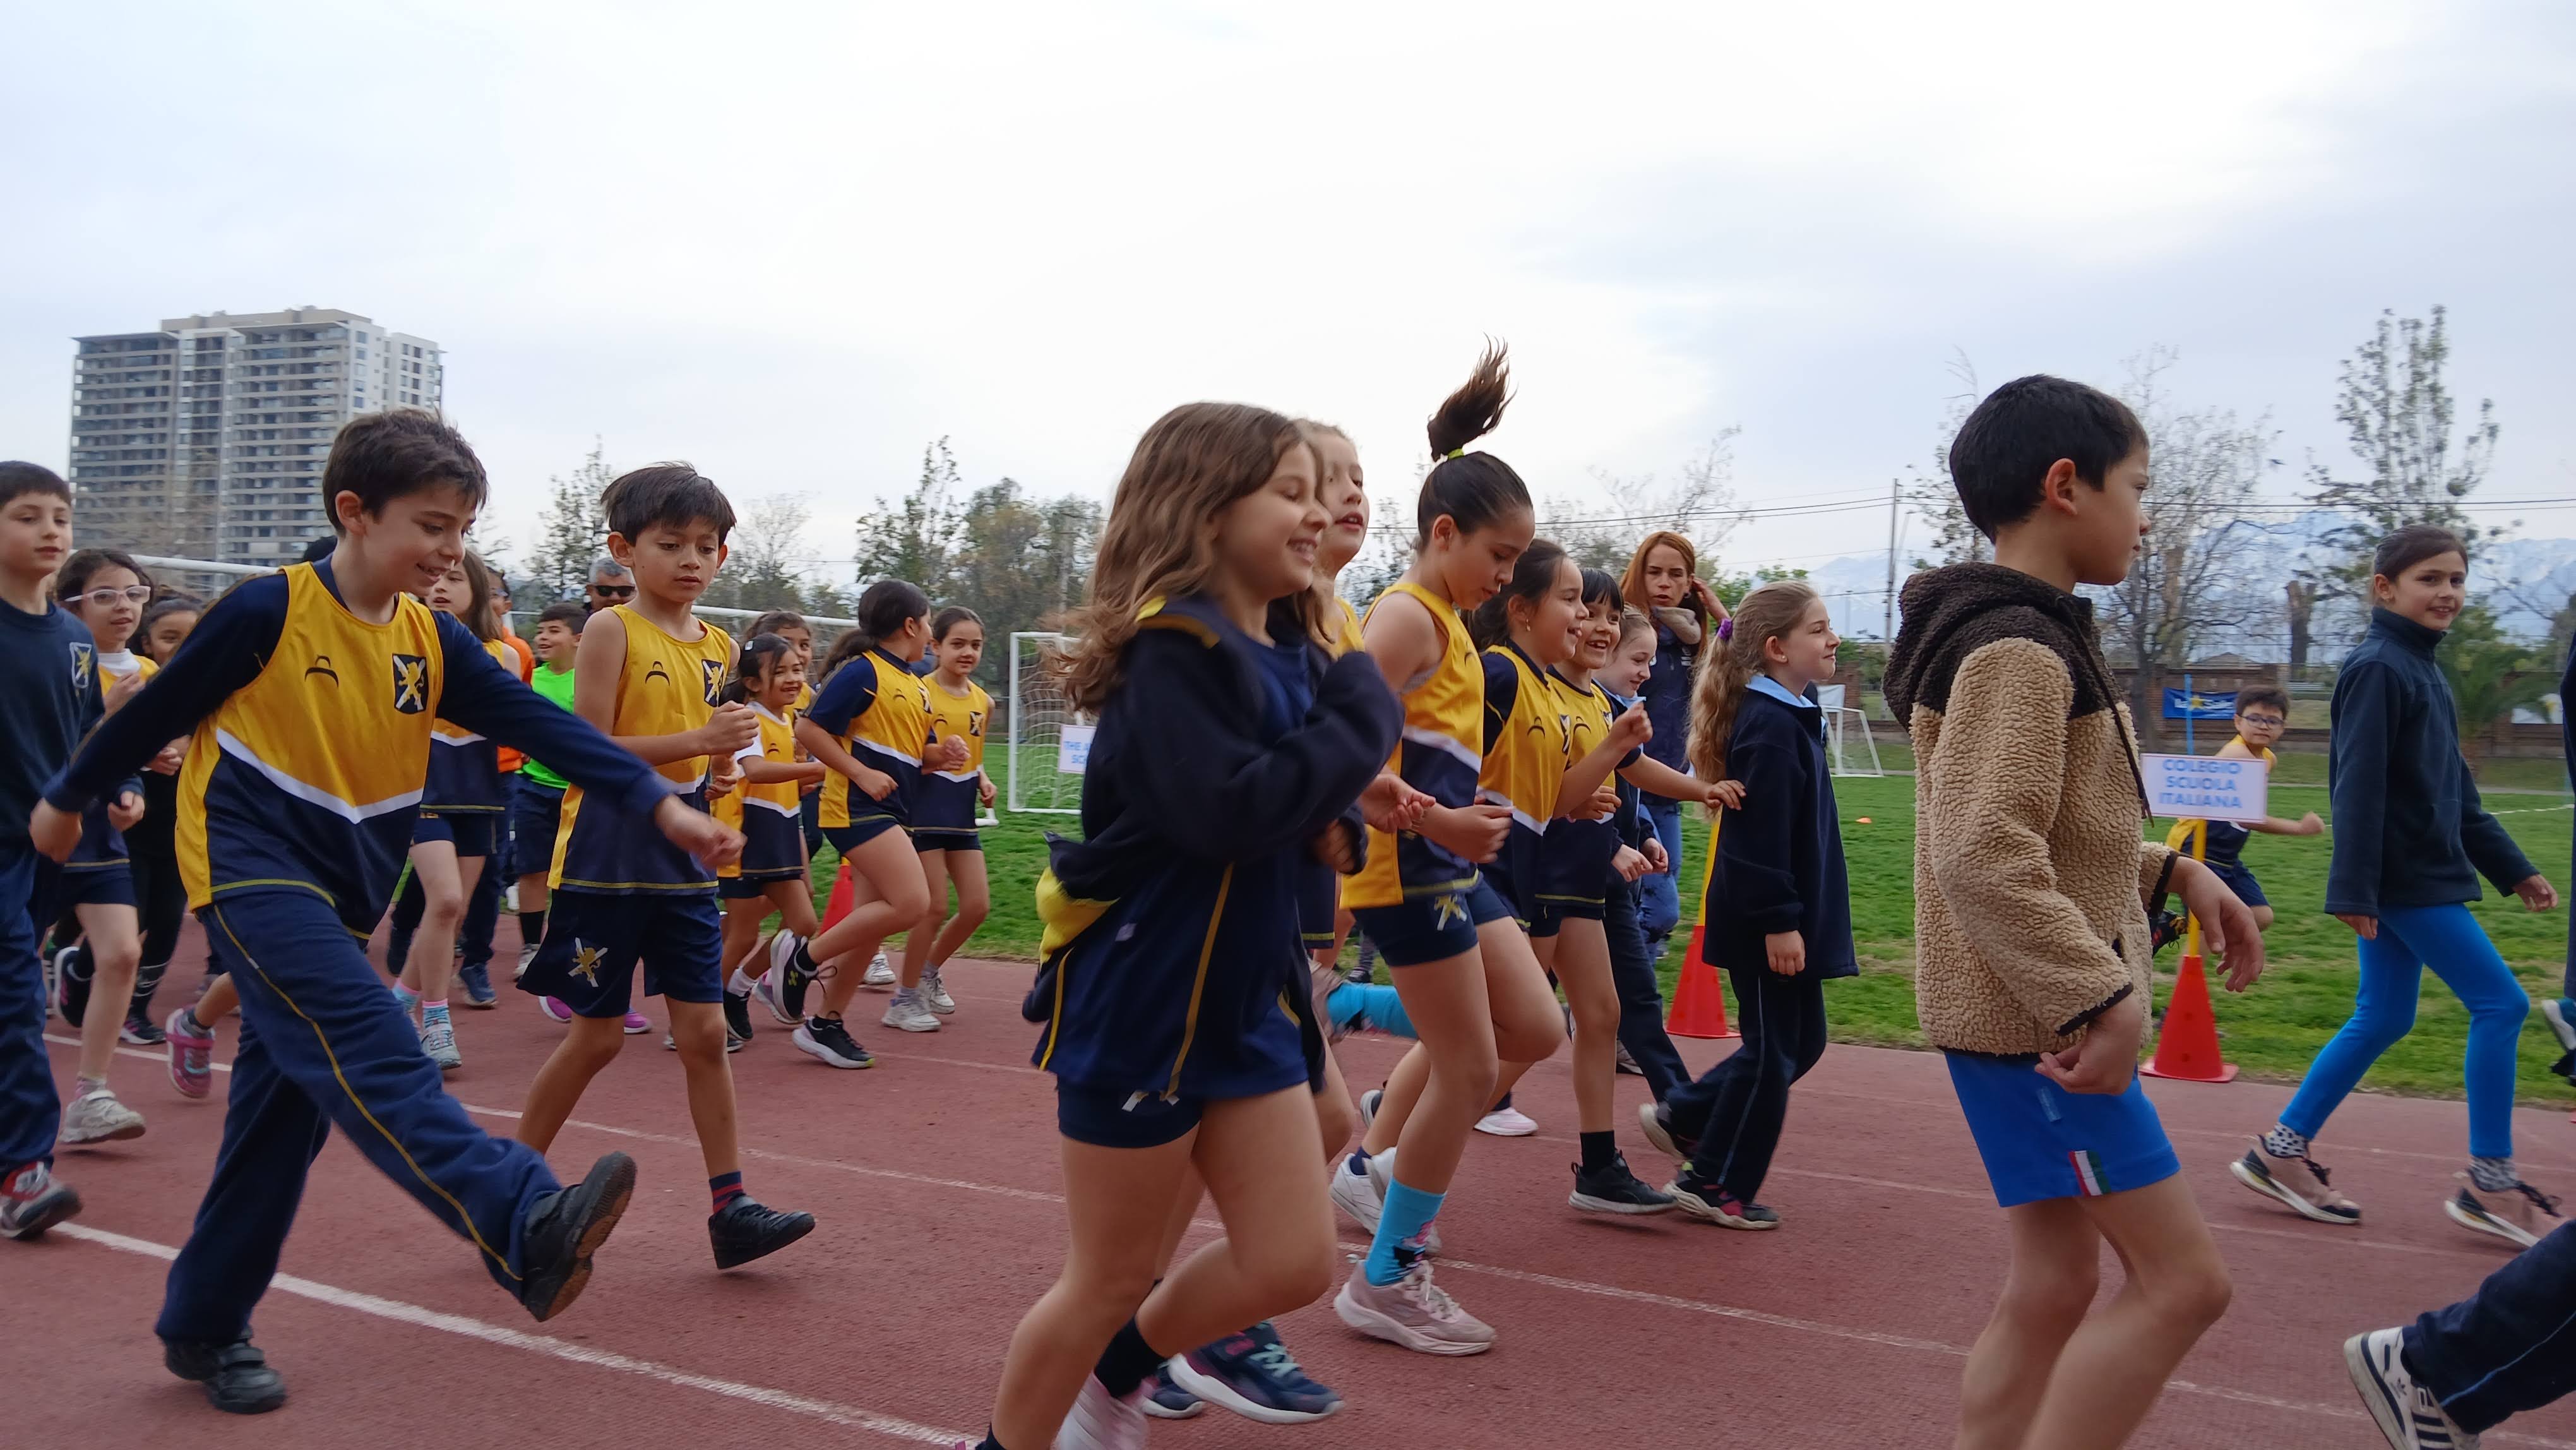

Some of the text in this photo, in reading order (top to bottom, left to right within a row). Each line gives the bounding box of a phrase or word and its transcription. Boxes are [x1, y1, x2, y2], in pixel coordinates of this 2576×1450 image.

[2164, 759, 2241, 774] COLEGIO
[2166, 776, 2236, 791] SCUOLA
[2161, 793, 2242, 808] ITALIANA
